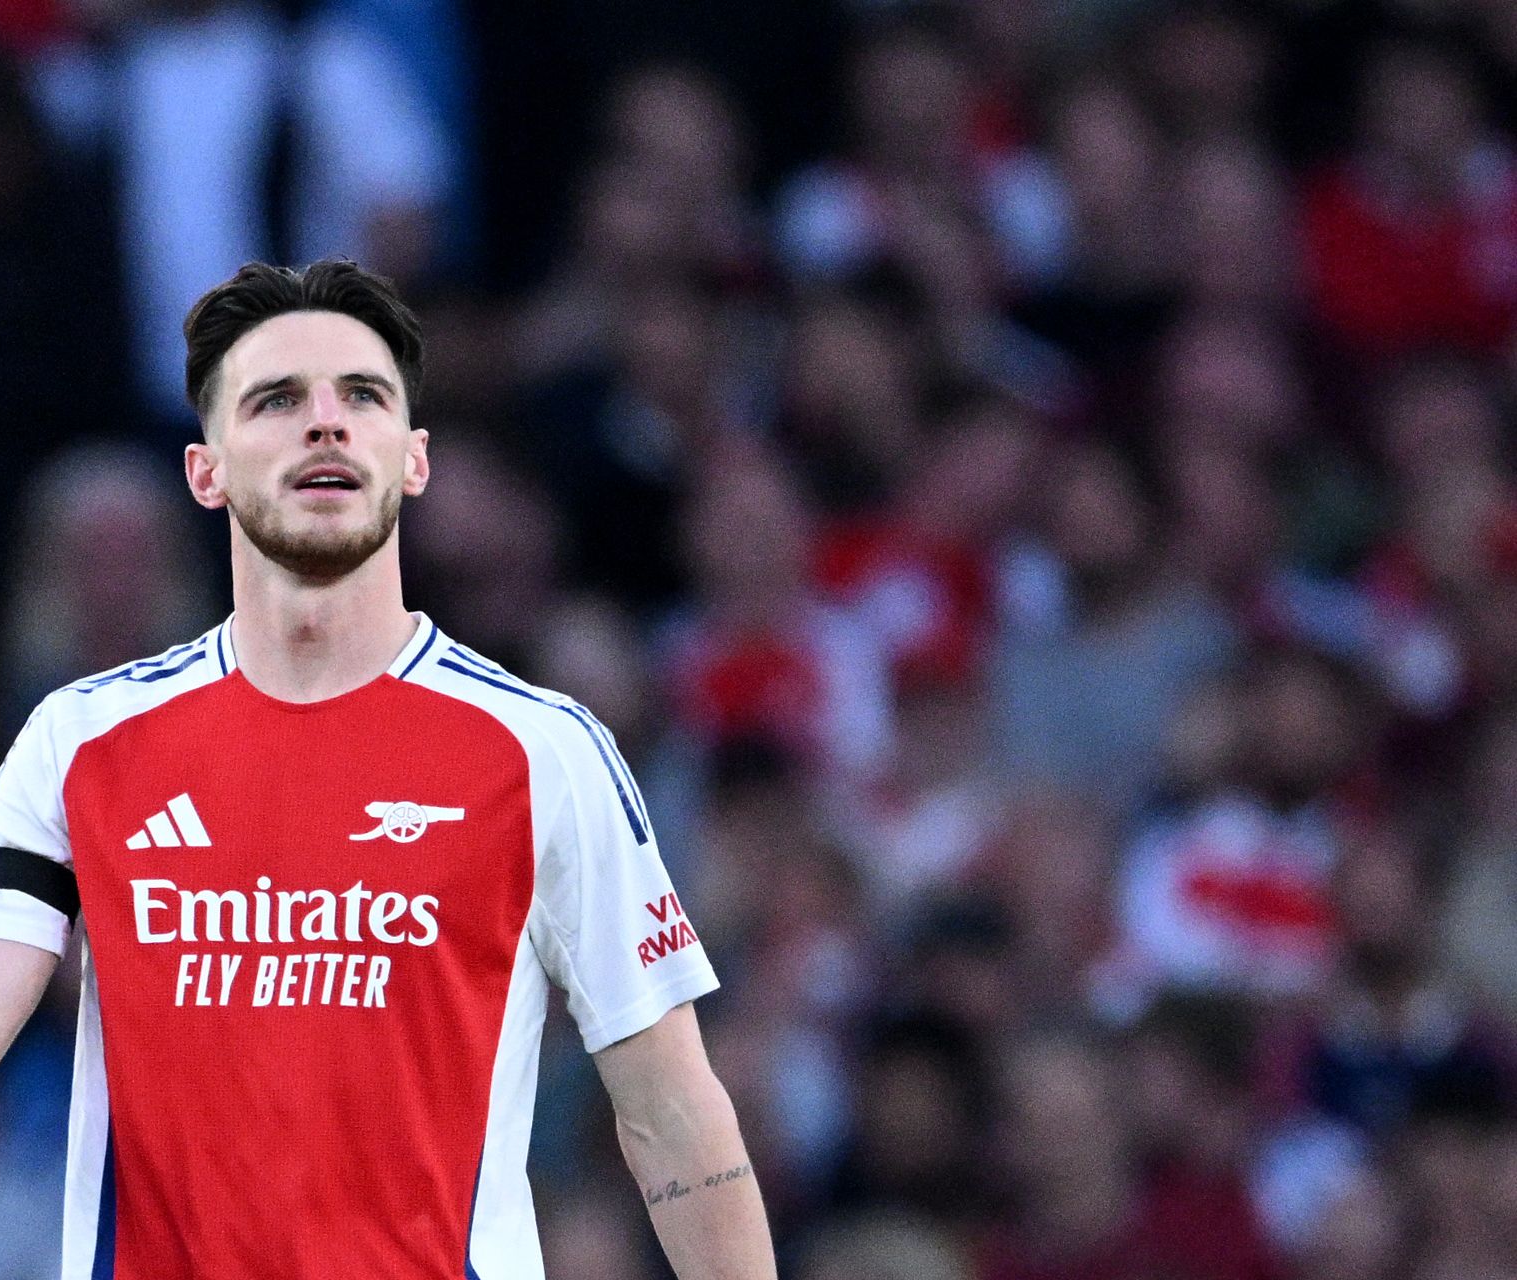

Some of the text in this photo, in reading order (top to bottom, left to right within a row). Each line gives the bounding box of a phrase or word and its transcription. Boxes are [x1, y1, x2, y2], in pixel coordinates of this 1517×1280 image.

[129, 875, 439, 947] Emirates
[645, 892, 682, 924] VI
[637, 921, 698, 969] RWA
[175, 952, 392, 1009] FLY BETTER
